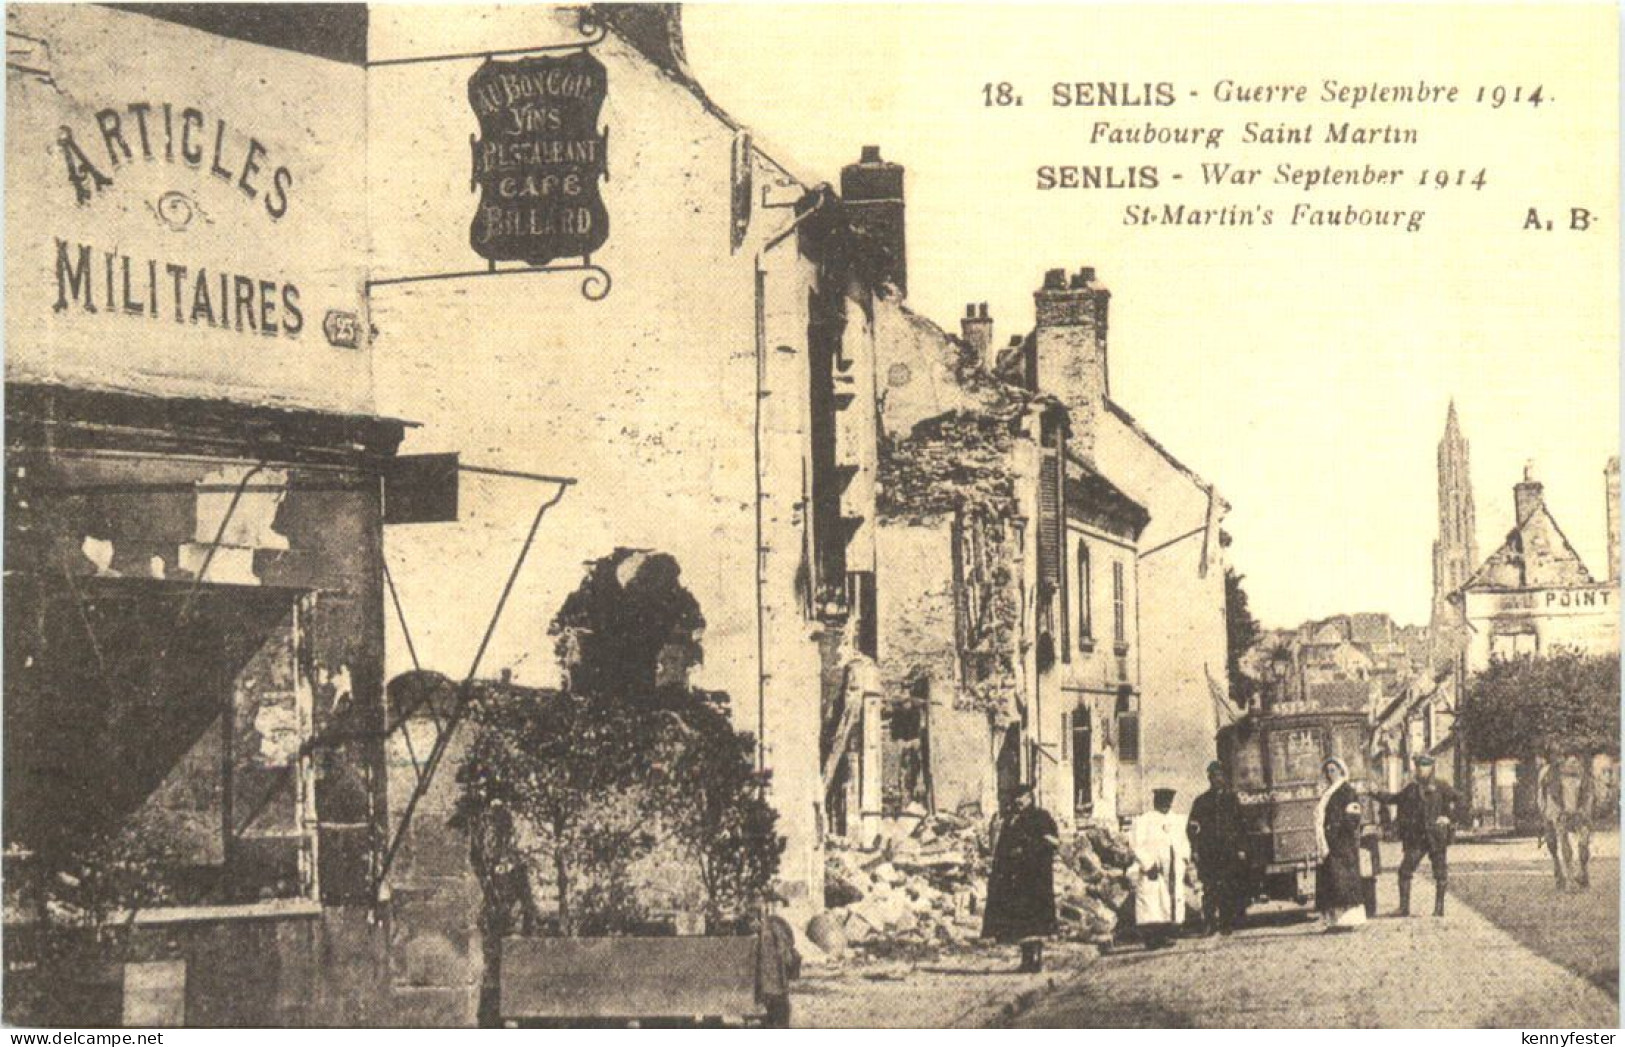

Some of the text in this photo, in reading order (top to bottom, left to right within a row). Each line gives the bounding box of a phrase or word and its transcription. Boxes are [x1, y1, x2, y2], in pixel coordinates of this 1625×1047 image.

[55, 102, 293, 221] ARTICLES
[53, 237, 304, 338] MILITAIRES
[1546, 591, 1611, 608] POINT
